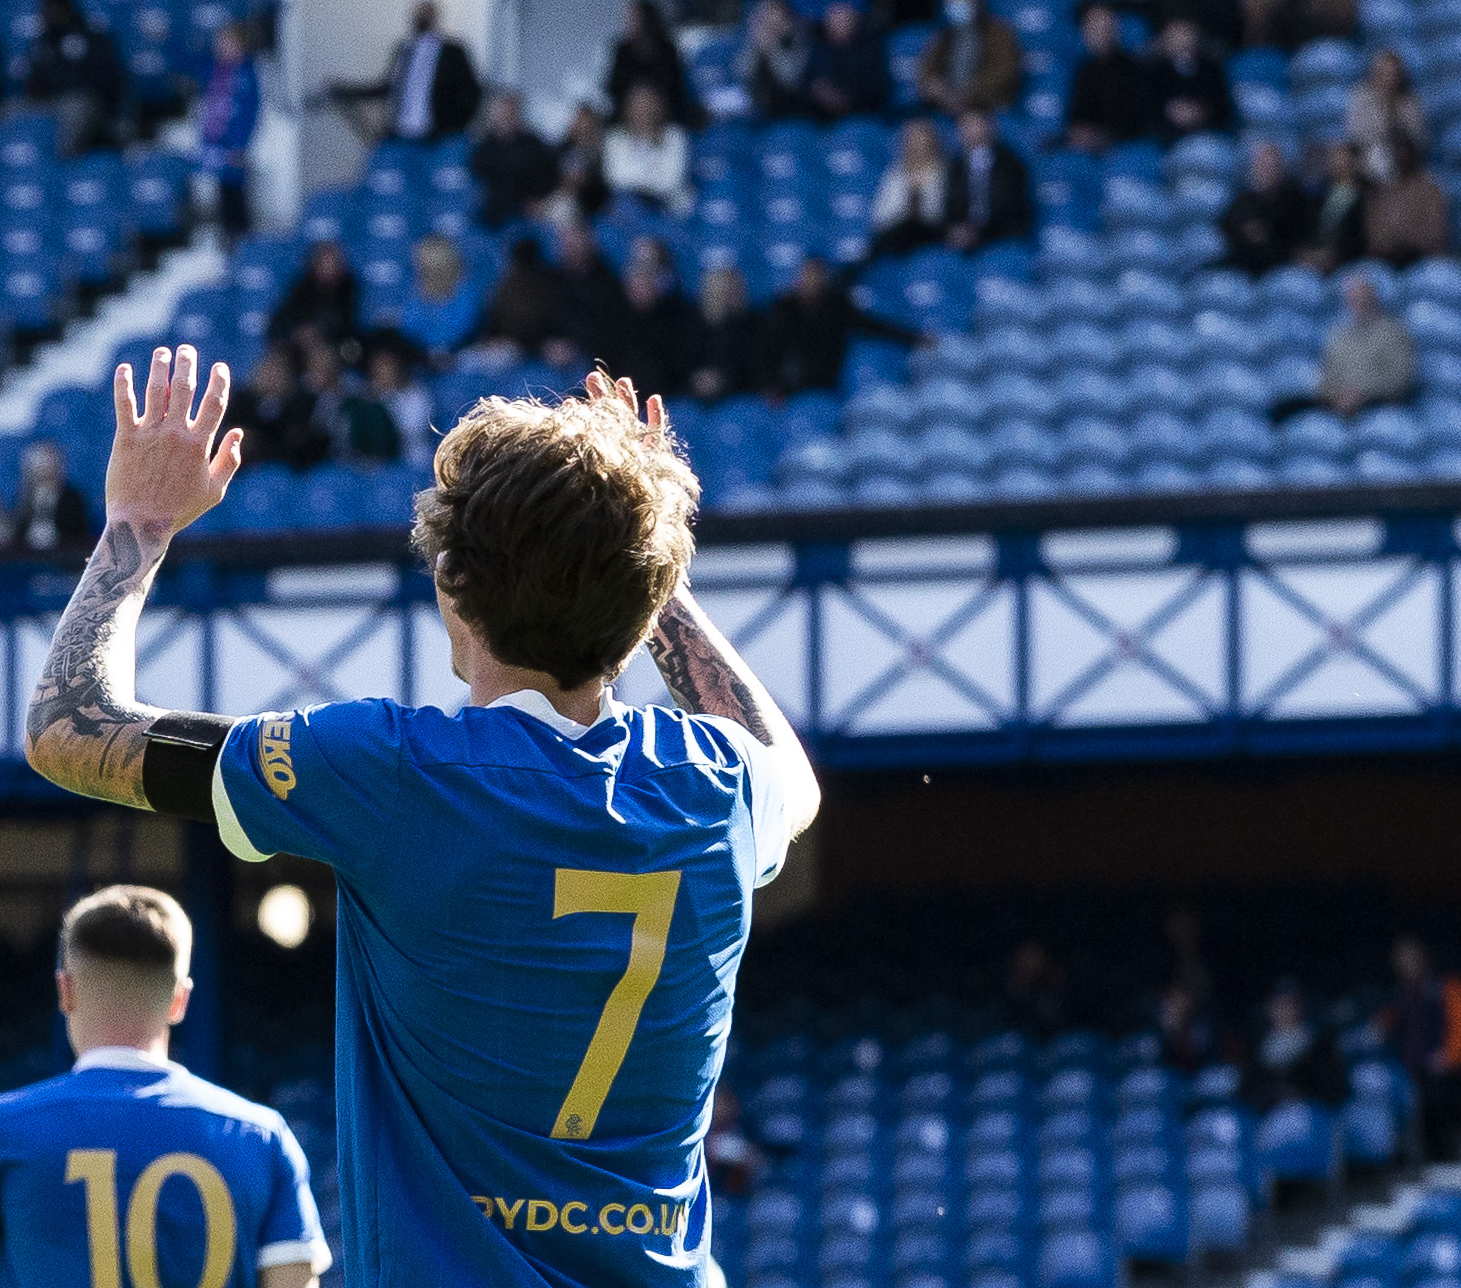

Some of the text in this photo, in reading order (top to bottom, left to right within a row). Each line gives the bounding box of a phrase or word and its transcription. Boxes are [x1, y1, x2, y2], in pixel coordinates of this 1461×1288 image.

[259, 713, 297, 800] EKO
[550, 867, 682, 1140] 7
[470, 1195, 685, 1236] YDC.CO.U
